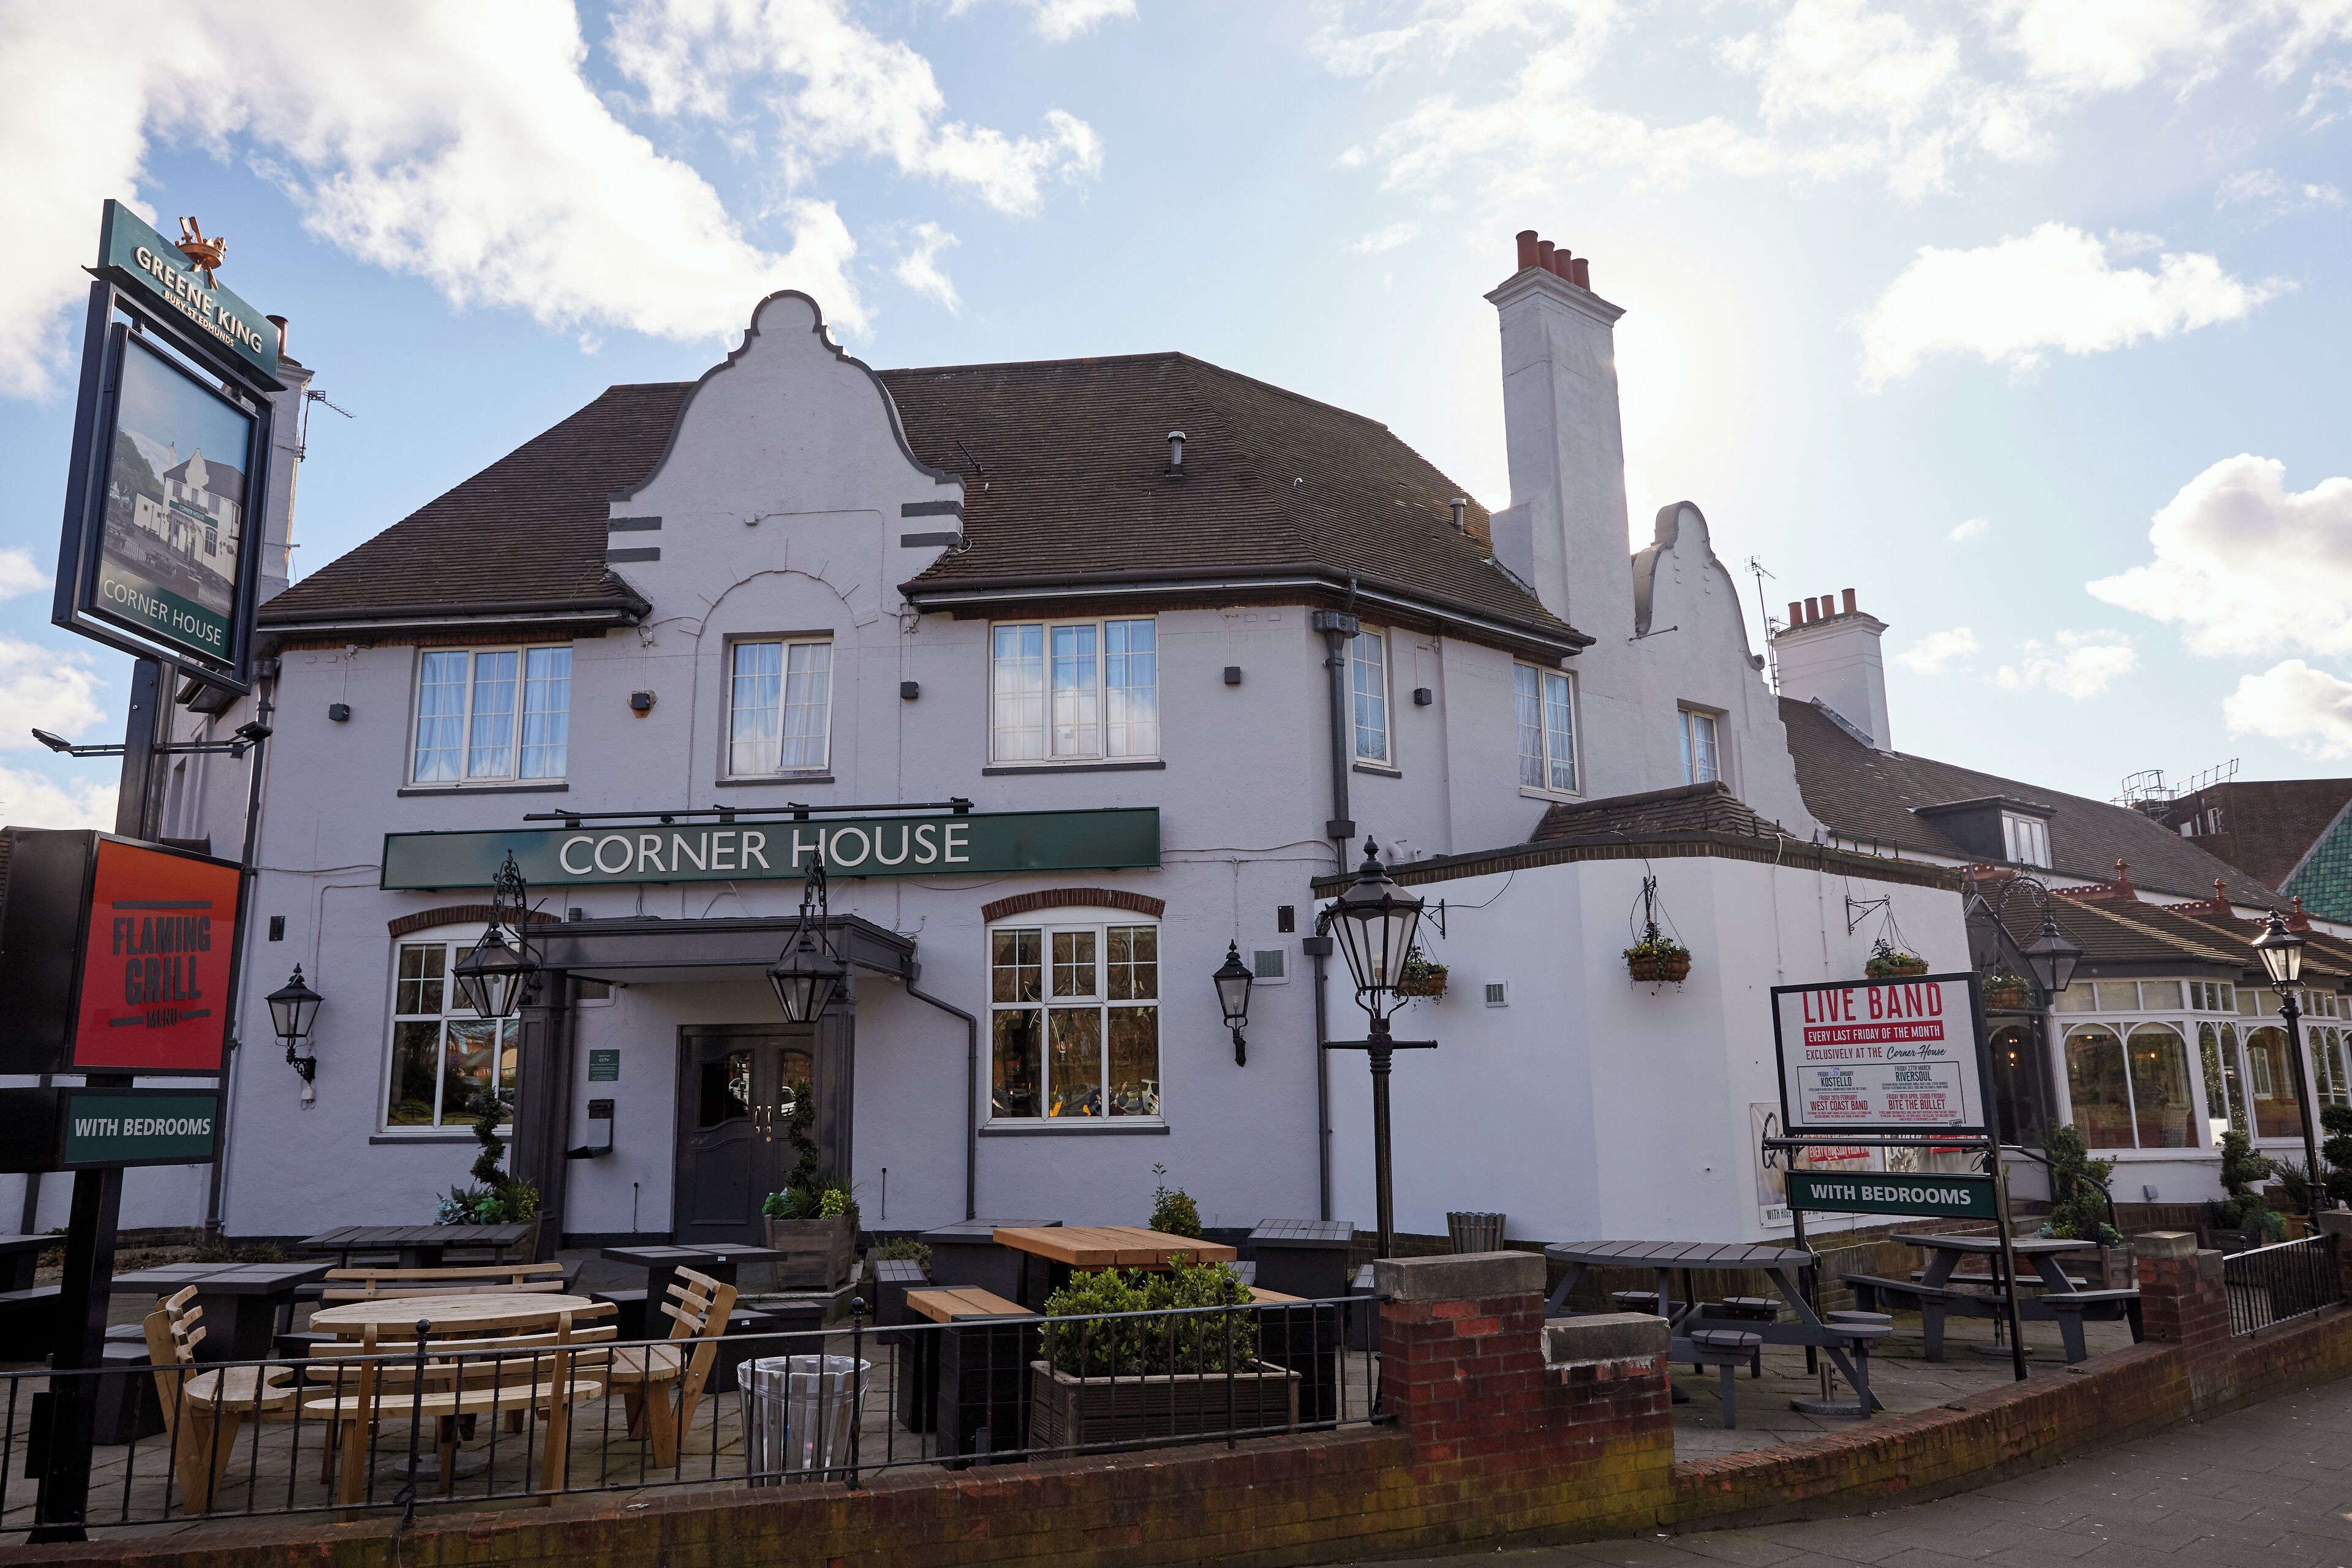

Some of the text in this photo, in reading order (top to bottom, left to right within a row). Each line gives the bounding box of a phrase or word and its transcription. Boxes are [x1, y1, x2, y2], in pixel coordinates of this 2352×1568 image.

[136, 246, 263, 353] GREENE KING
[164, 290, 235, 348] BURY ST EDMUNDS
[104, 579, 222, 646] CORNER HOUSE
[559, 823, 970, 876] CORNER HOUSE
[113, 916, 211, 956] FLAMING
[125, 956, 202, 1006] GRILL
[1803, 982, 1943, 1023] LIVE BAND
[146, 1008, 179, 1029] MENU
[1808, 1025, 1940, 1042] EVERY LAST FRIDAY OF THE MONTH
[1806, 1044, 1947, 1060] EXCLUSIVELY AT THE Corner House
[1821, 1077, 1852, 1087] KOSTELLO
[1896, 1071, 1932, 1082] RIVERSOUL
[1810, 1100, 1868, 1111] WEST COAST BAND
[1888, 1099, 1945, 1110] BITE THE BULLET
[75, 1118, 211, 1137] WITH BEDROOMS
[1811, 1184, 1972, 1205] WITH BEDROOMS
[1766, 1209, 1780, 1220] WITH
